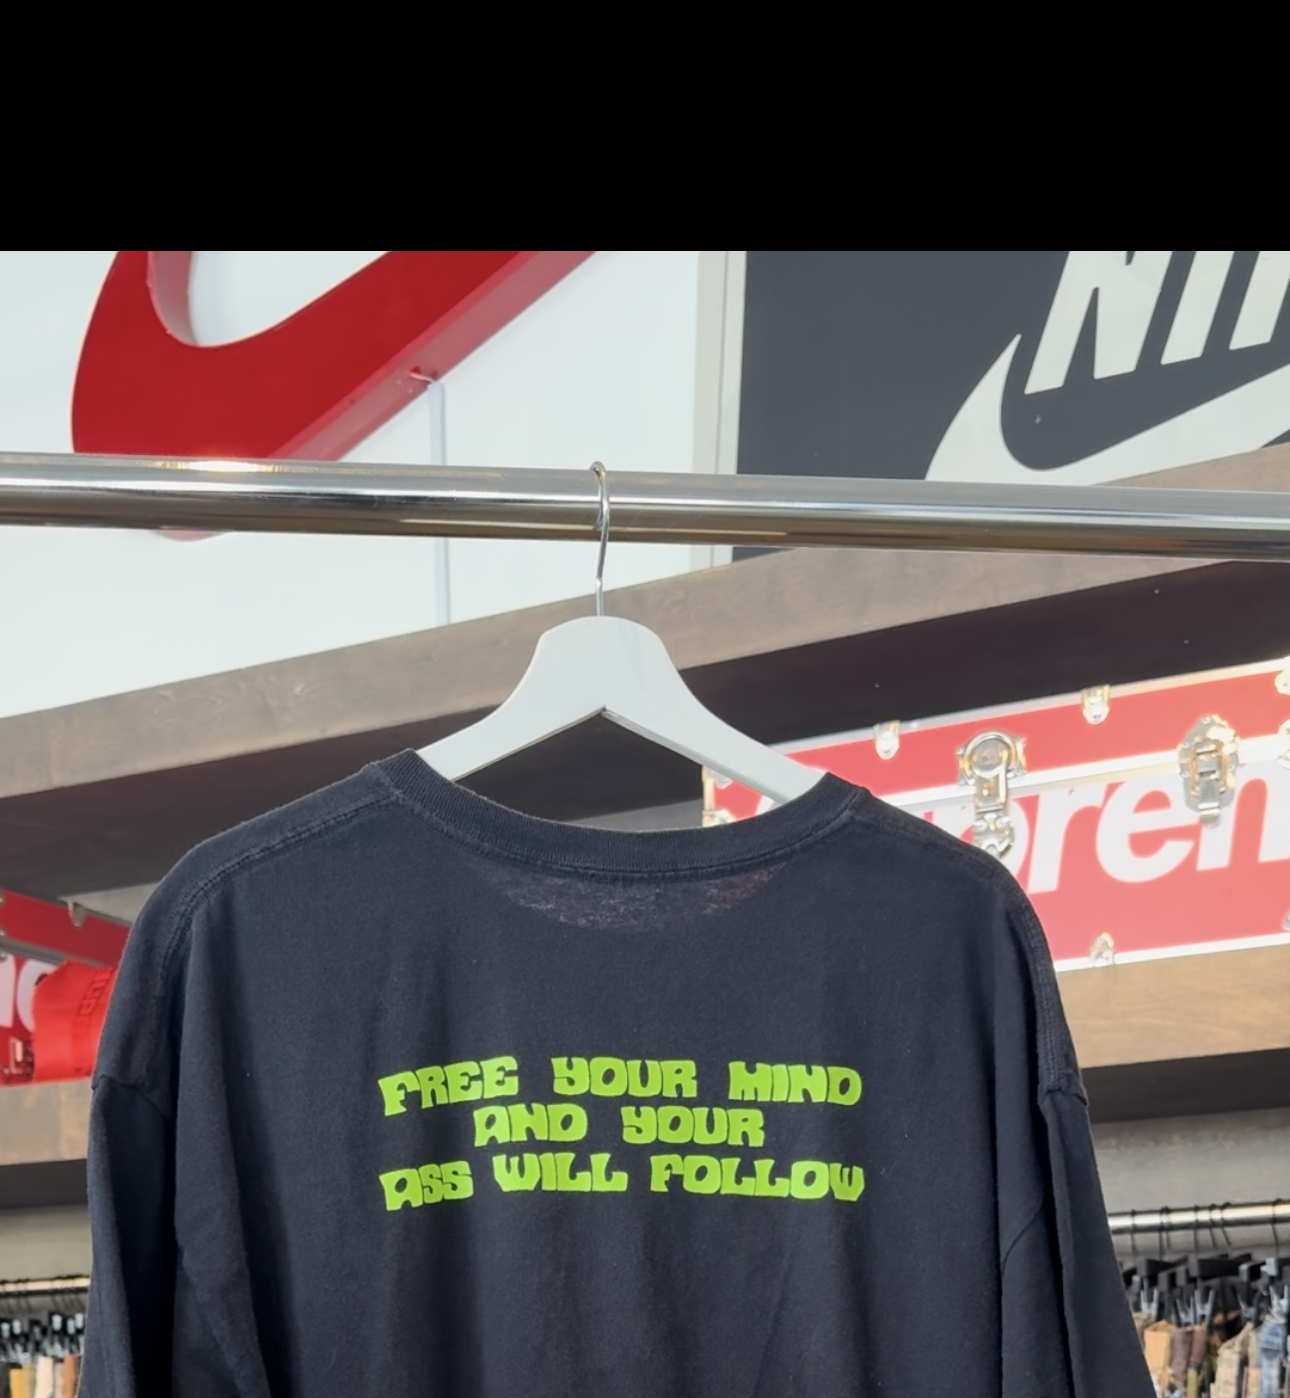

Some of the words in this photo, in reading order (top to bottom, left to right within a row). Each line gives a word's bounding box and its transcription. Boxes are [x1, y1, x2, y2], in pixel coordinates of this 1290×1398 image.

[379, 1056, 518, 1116] FREE
[552, 1057, 698, 1098] YOUR
[728, 1061, 862, 1106] MIND
[474, 1103, 588, 1147] AND
[621, 1105, 765, 1147] YOUR
[379, 1161, 473, 1211] ASS
[493, 1152, 628, 1193] WILL
[651, 1154, 865, 1202] FOLLOW
